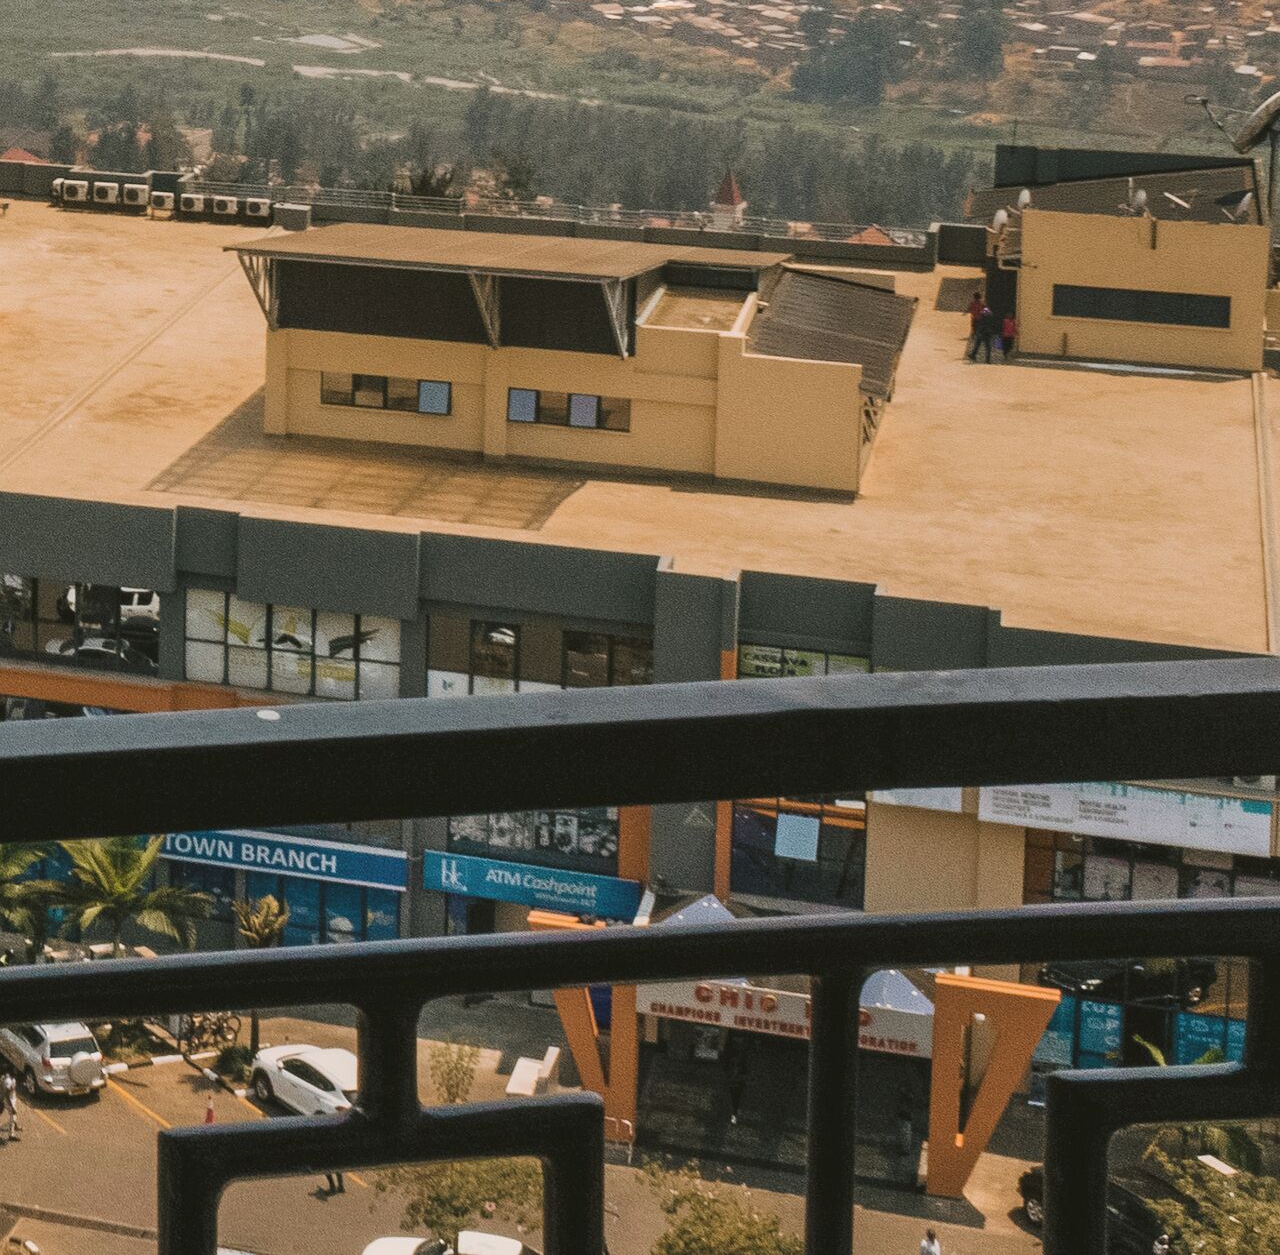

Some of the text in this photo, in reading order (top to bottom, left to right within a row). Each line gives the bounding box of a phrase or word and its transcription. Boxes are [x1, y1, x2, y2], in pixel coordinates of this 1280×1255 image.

[165, 832, 337, 874] TOWN BRANCH
[485, 868, 521, 887] ATM
[522, 874, 598, 897] Cashpoint
[650, 1001, 721, 1023] CHAMPIONS
[694, 984, 777, 1013] CHIC
